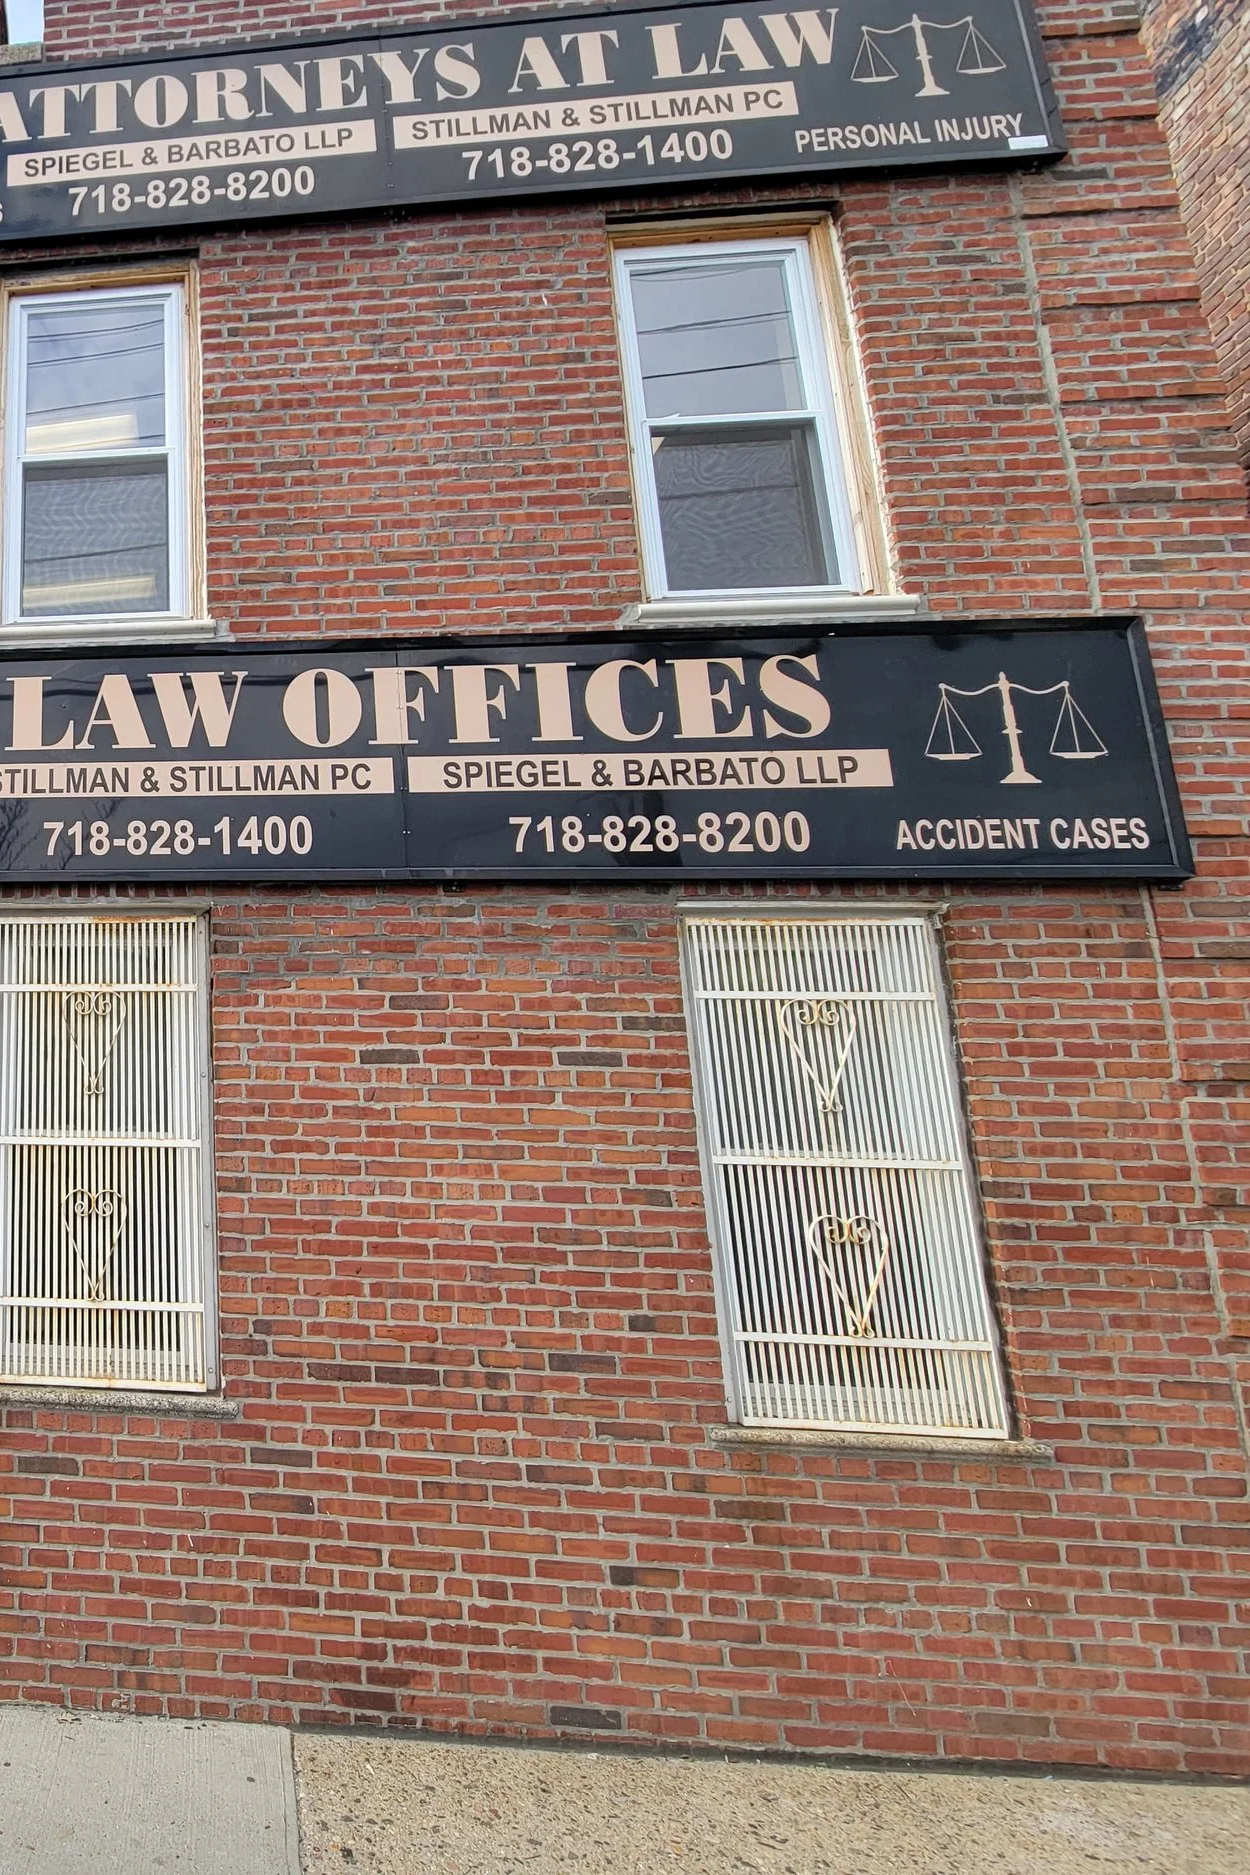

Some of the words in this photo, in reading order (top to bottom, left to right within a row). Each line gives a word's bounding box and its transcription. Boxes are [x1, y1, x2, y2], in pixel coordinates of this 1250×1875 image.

[507, 29, 620, 94] AT
[644, 8, 841, 80] LAW
[410, 108, 552, 142] STILLMAN
[560, 106, 581, 128] &
[588, 92, 734, 125] STILLMAN
[744, 88, 785, 113] PC
[793, 120, 931, 154] PERSONAL
[933, 112, 1023, 142] INJURY
[23, 149, 134, 178] SPIEGEL
[141, 146, 159, 167] &
[167, 132, 296, 164] BARBATO
[304, 126, 354, 151] LLP
[461, 127, 734, 182] 718-828-1400
[67, 164, 316, 217] 718-828-8200
[3, 669, 249, 751] LAW
[281, 653, 833, 750] OFFICES
[140, 765, 161, 793] &
[168, 763, 320, 793] STILLMAN
[330, 762, 373, 791] PC
[441, 758, 585, 789] SPIEGEL
[591, 758, 614, 788] &
[624, 756, 787, 787] BARBATO
[796, 755, 860, 785] LLP
[43, 815, 314, 858] 718-828-1400
[507, 809, 812, 854] 718-828-8200
[895, 817, 1041, 851] ACCIDENT
[1048, 816, 1150, 850] CASES
